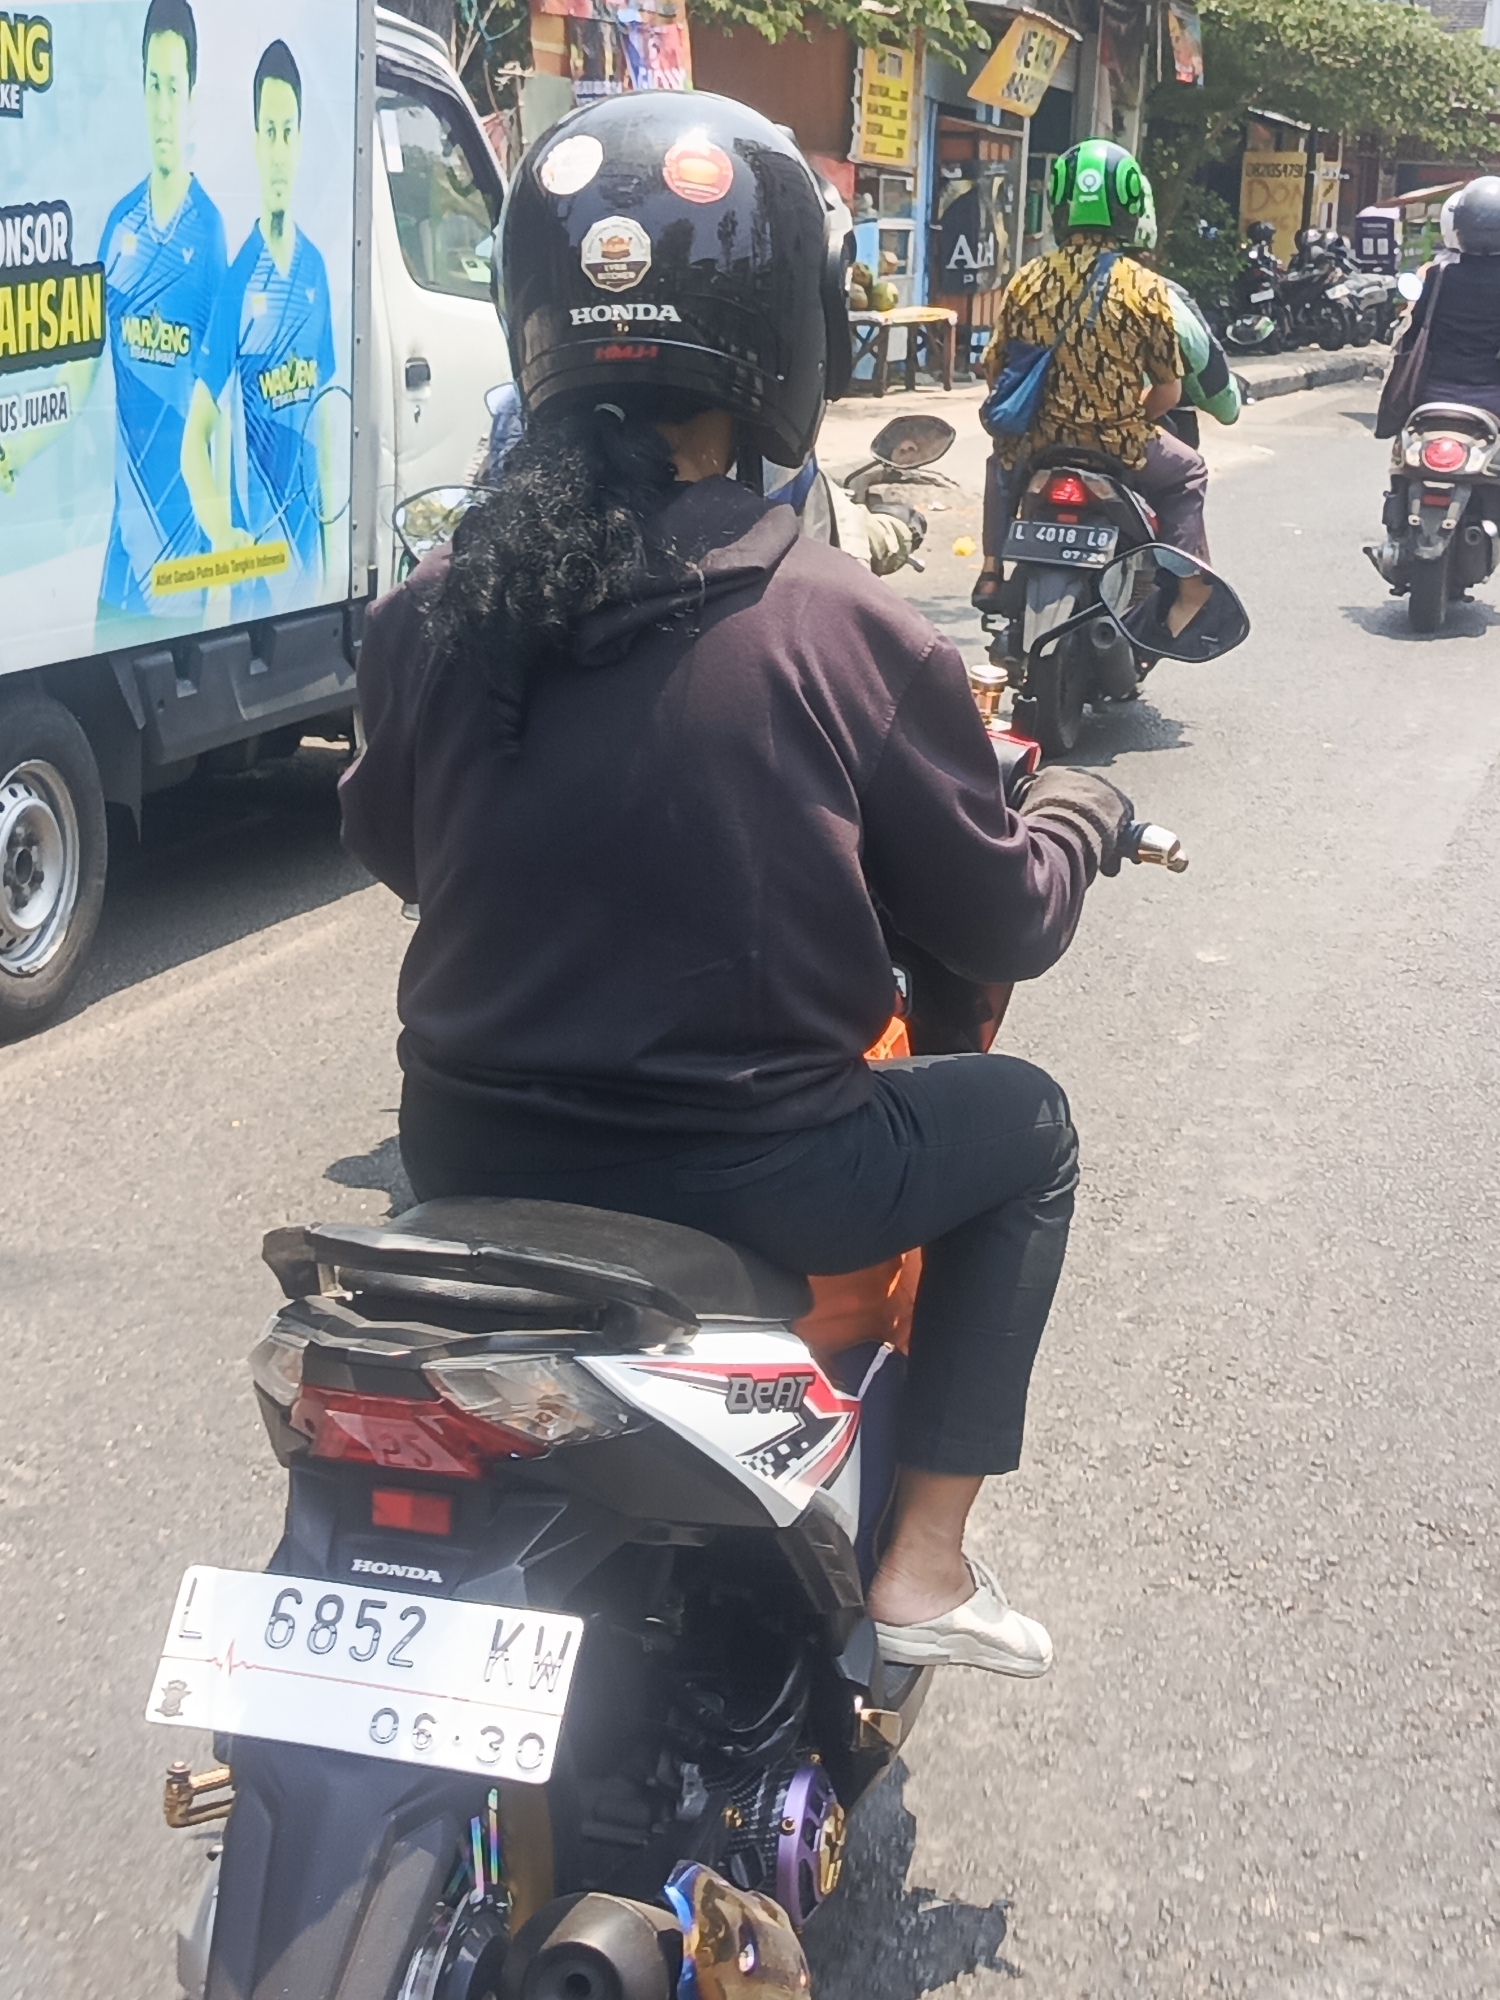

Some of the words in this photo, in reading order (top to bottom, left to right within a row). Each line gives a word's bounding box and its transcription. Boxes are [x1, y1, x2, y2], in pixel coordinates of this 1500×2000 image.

[569, 303, 682, 325] HONDA
[22, 391, 68, 429] JUARA
[1015, 525, 1025, 540] L
[1036, 526, 1077, 544] 4018
[726, 1373, 815, 1414] BeAT
[350, 1559, 443, 1583] HONDA
[179, 1577, 202, 1640] L
[265, 1587, 427, 1669] 6852
[483, 1618, 573, 1693] KW
